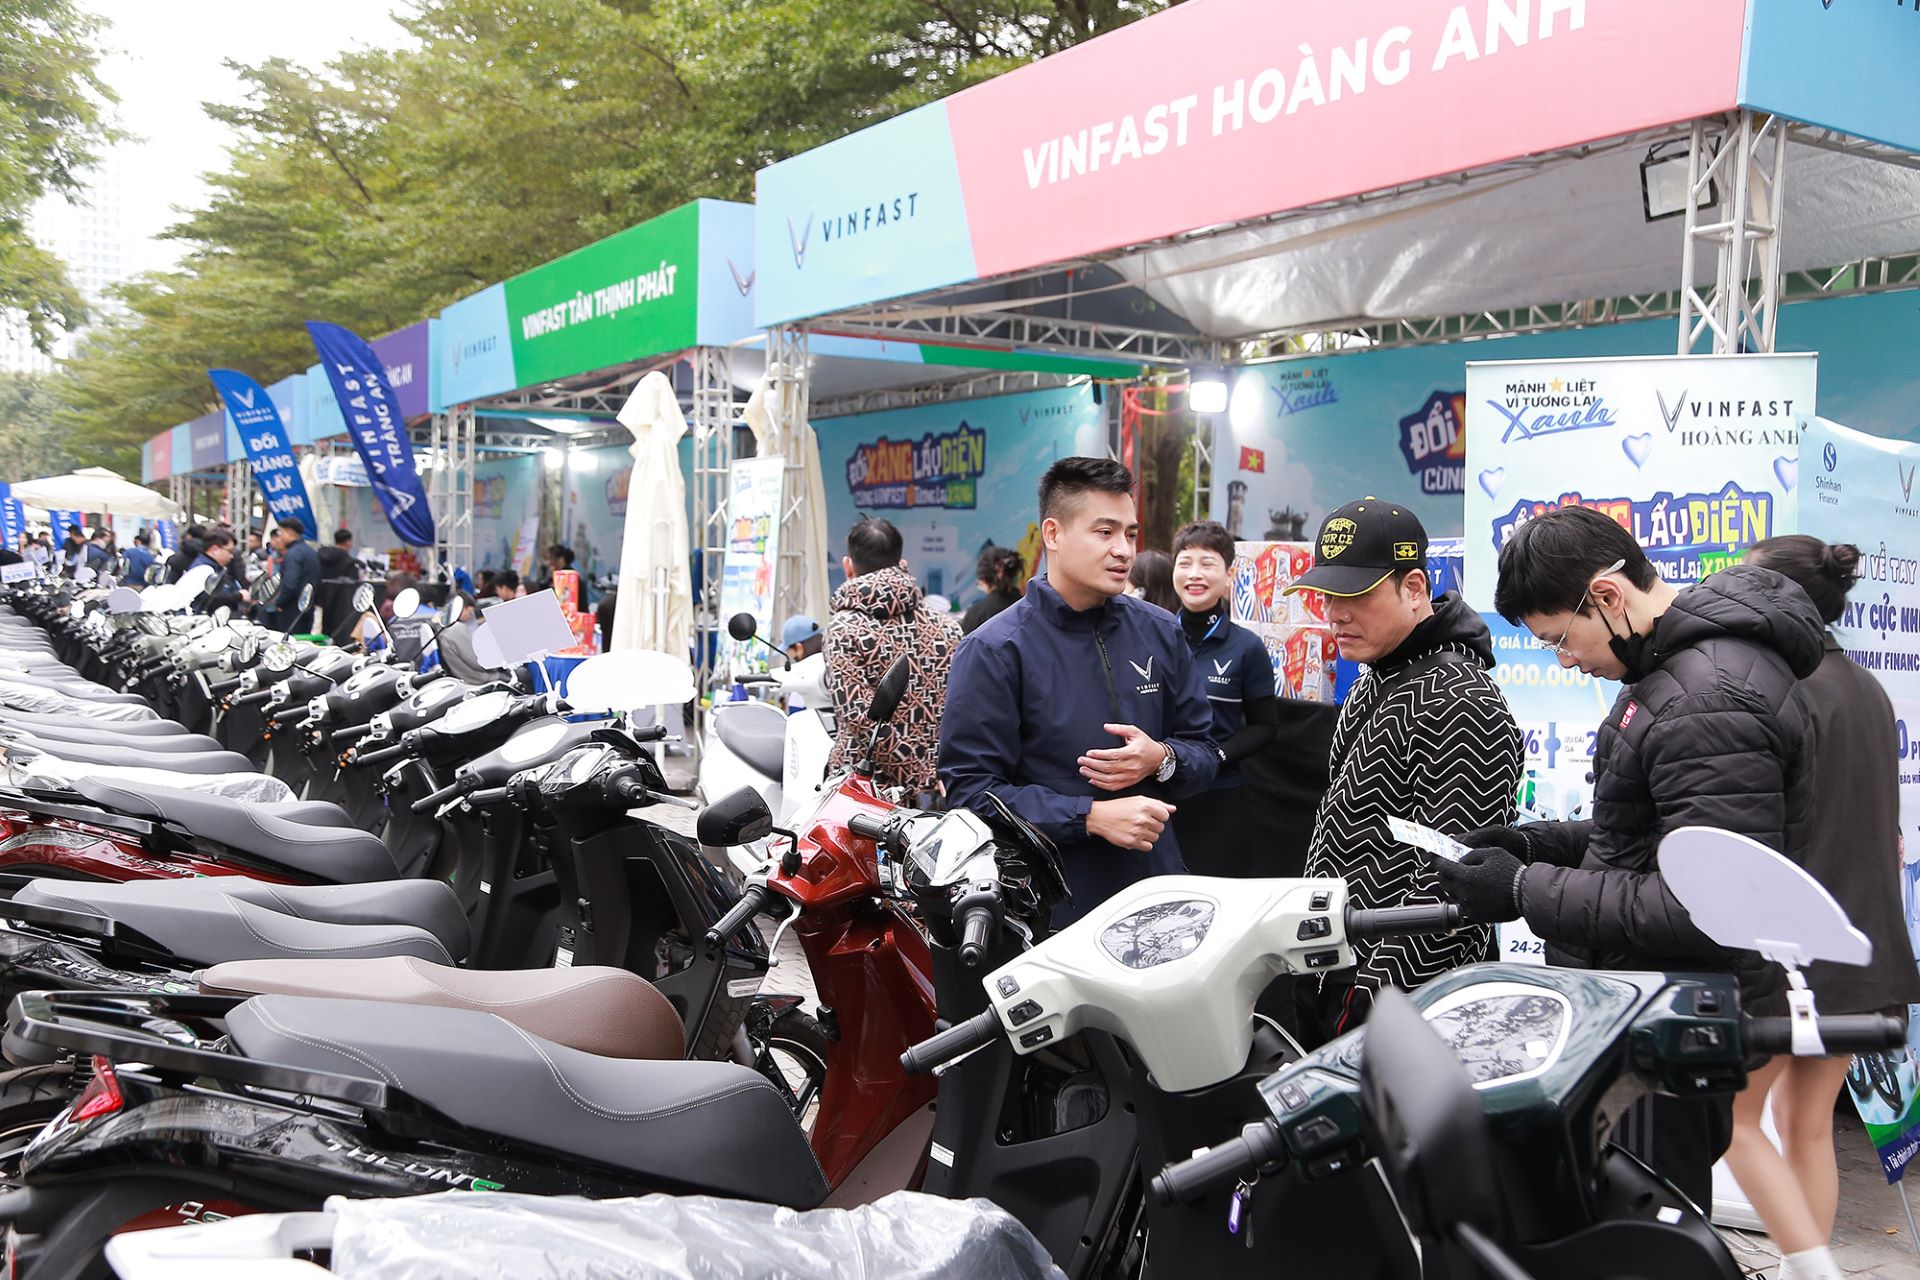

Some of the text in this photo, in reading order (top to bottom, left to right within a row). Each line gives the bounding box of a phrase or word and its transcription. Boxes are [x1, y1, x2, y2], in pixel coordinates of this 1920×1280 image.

[1022, 94, 1198, 190] VINFAST
[1210, 25, 1412, 137] HOÀNG
[822, 192, 920, 243] VINFAST
[522, 260, 677, 340] VINFAST TÂN THỊNH PHÁT
[1506, 378, 1596, 395] MÃNH LIỆT
[1506, 395, 1519, 408] VÌ
[1522, 395, 1571, 408] TƯƠNG
[1691, 400, 1794, 419] VINFAST
[336, 362, 386, 474] VINFAST
[1486, 398, 1618, 444] Xanh
[1681, 425, 1799, 447] HOÀNG ANH
[251, 454, 294, 474] XĂNG
[1815, 475, 1842, 493] Shinhan
[1633, 497, 1690, 549] LẤY
[1700, 556, 1744, 579] XAN
[1870, 541, 1886, 581] VỀ
[1889, 557, 1917, 584] TAY
[1900, 607, 1920, 633] NH
[1499, 633, 1521, 649] GIÁ
[1510, 940, 1545, 954] 24-2
